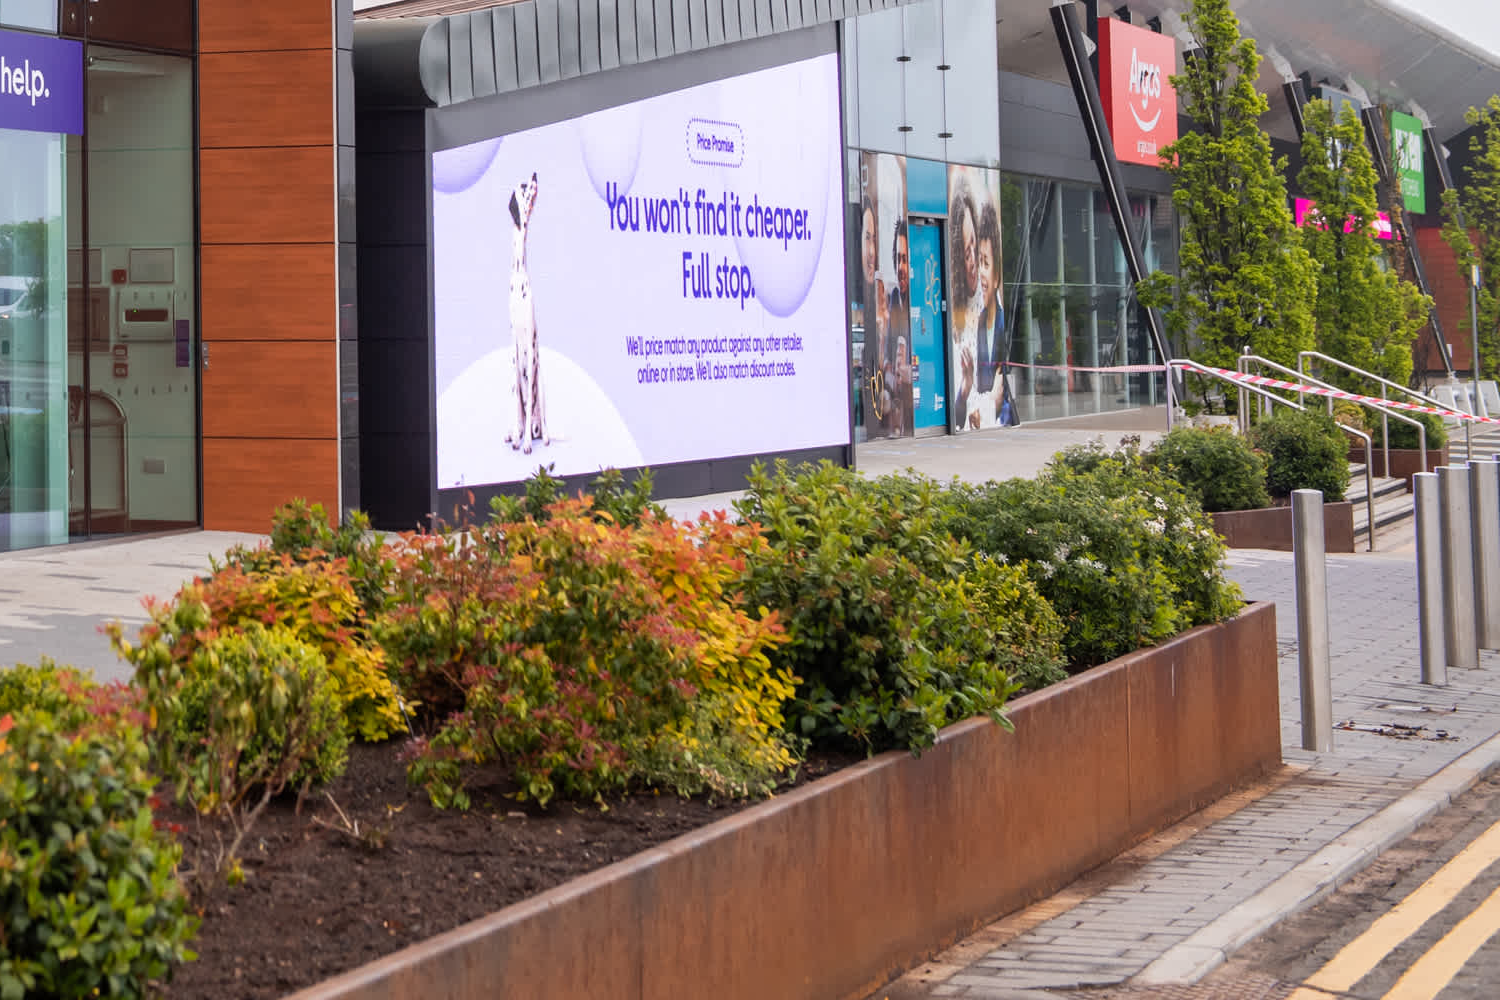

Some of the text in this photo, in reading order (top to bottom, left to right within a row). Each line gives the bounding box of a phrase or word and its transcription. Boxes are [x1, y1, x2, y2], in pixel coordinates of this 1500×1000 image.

[1, 56, 50, 106] help.
[1129, 47, 1161, 110] Argos
[697, 132, 734, 152] Price Promise
[606, 181, 811, 251] You won't find it cheaper.
[682, 252, 755, 311] Full stop.
[626, 336, 644, 356] We'll
[645, 336, 663, 360] price
[664, 336, 686, 355] match
[687, 338, 700, 359] any
[700, 335, 727, 359] product
[728, 334, 751, 357] against
[752, 336, 765, 356] any
[765, 334, 781, 352] other
[637, 358, 796, 384] online or in store. We'll also match discount codes.
